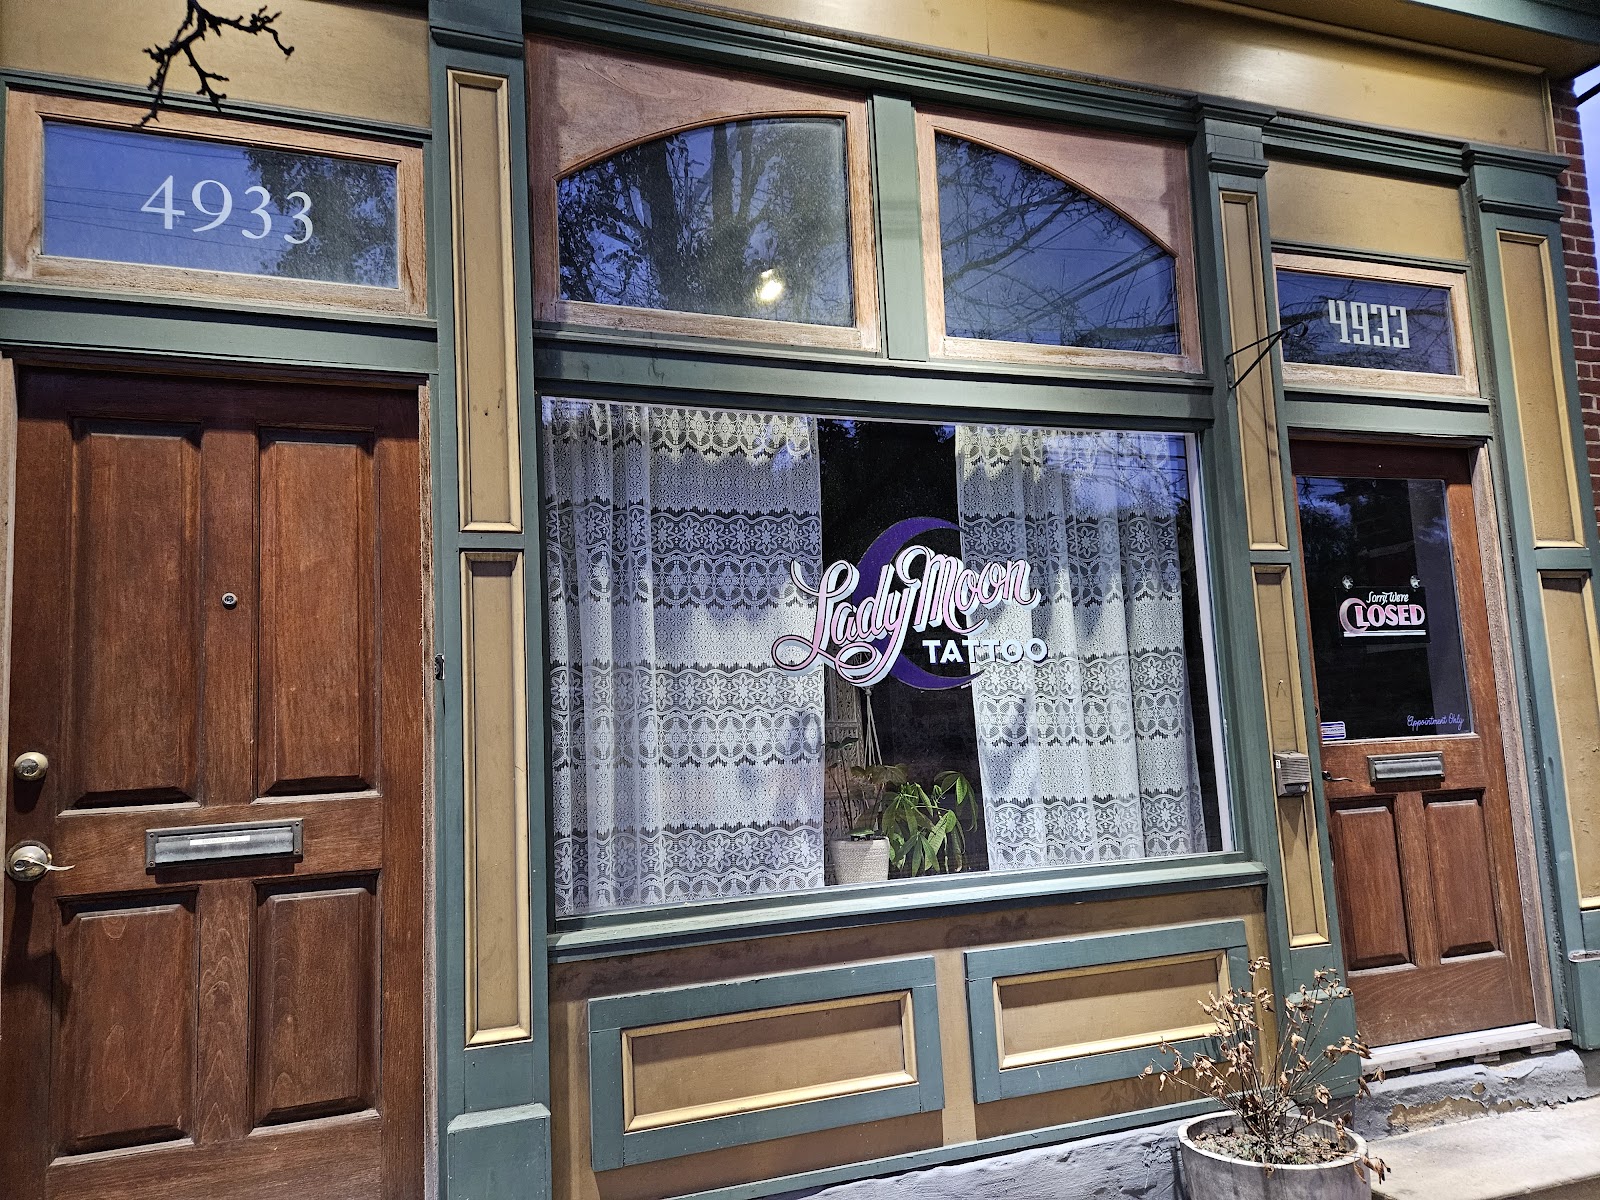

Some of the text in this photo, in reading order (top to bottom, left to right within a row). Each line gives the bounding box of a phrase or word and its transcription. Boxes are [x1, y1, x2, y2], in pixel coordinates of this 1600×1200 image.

[141, 175, 313, 244] 4933
[1328, 299, 1410, 349] 4933
[771, 545, 1041, 687] Lady Moon
[1339, 598, 1425, 634] CLOSED
[922, 637, 1048, 664] TATTOO
[1407, 713, 1464, 731] Appointment Only
